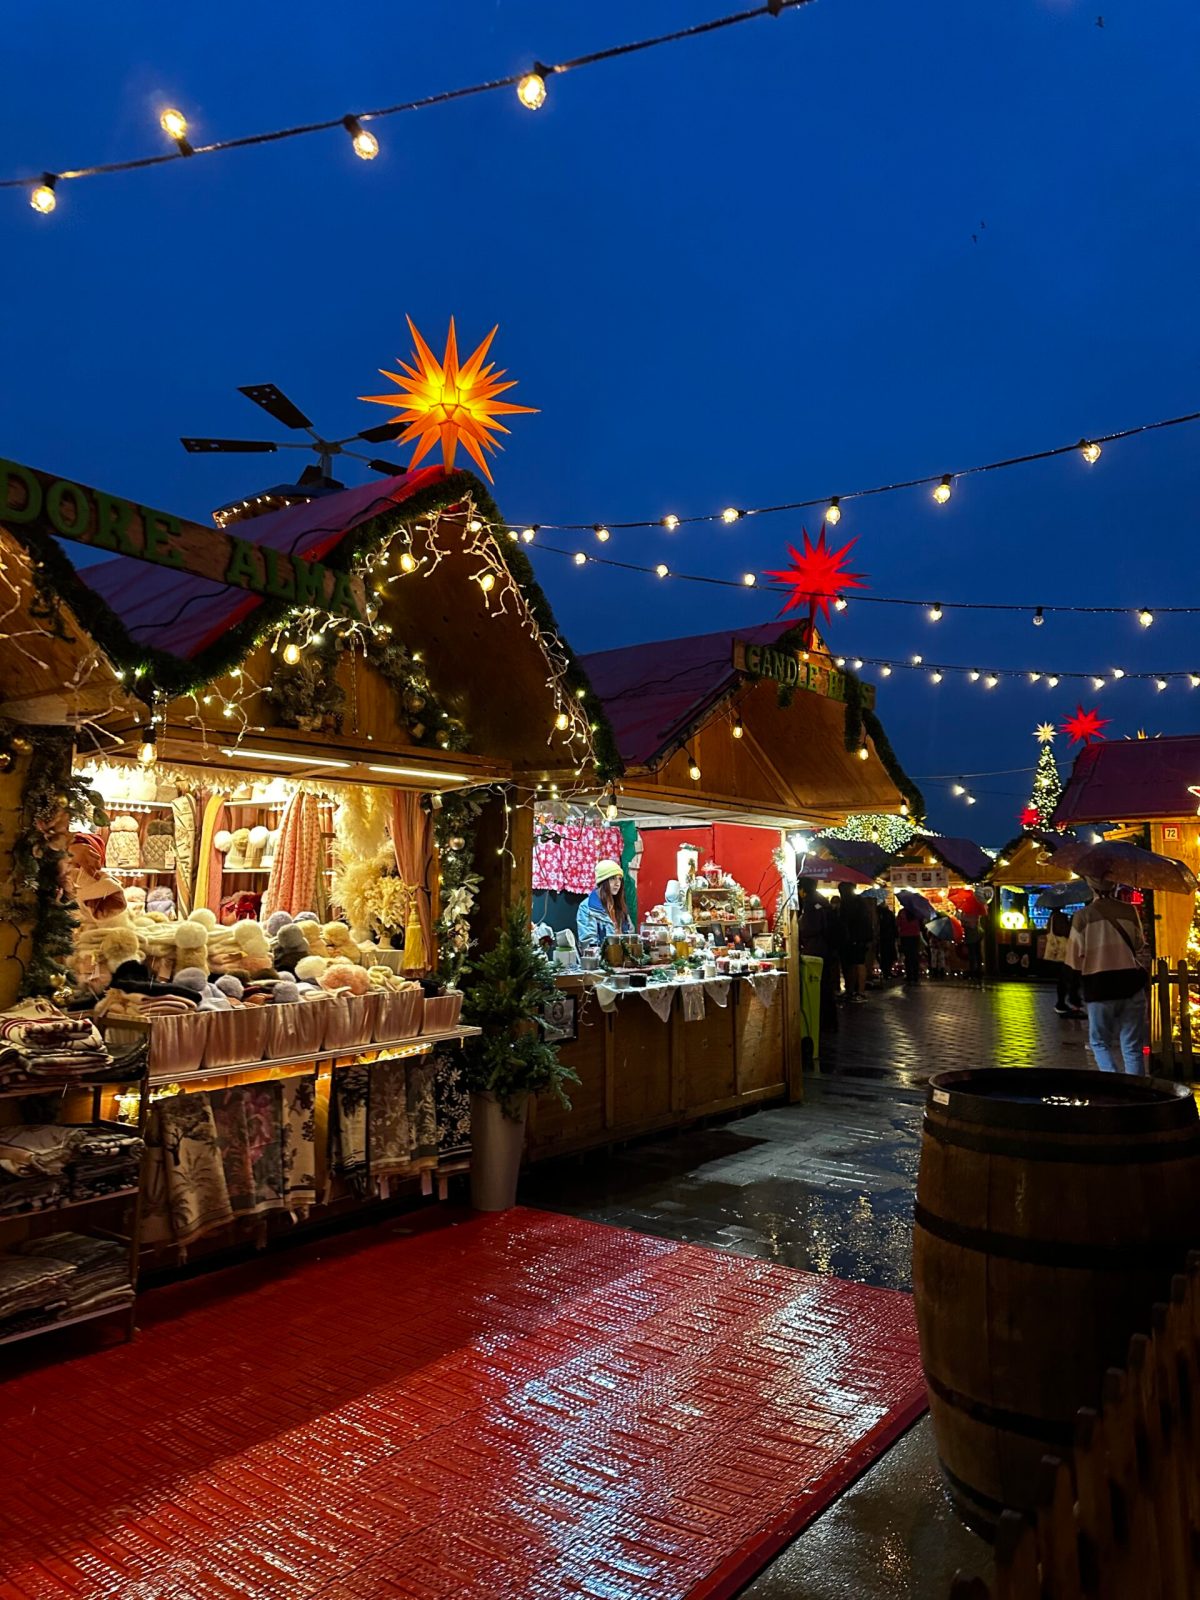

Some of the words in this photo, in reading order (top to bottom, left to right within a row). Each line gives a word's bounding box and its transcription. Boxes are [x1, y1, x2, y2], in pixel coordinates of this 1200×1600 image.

[0, 459, 183, 565] DORE
[226, 539, 361, 620] ALMA
[1166, 829, 1176, 838] 72
